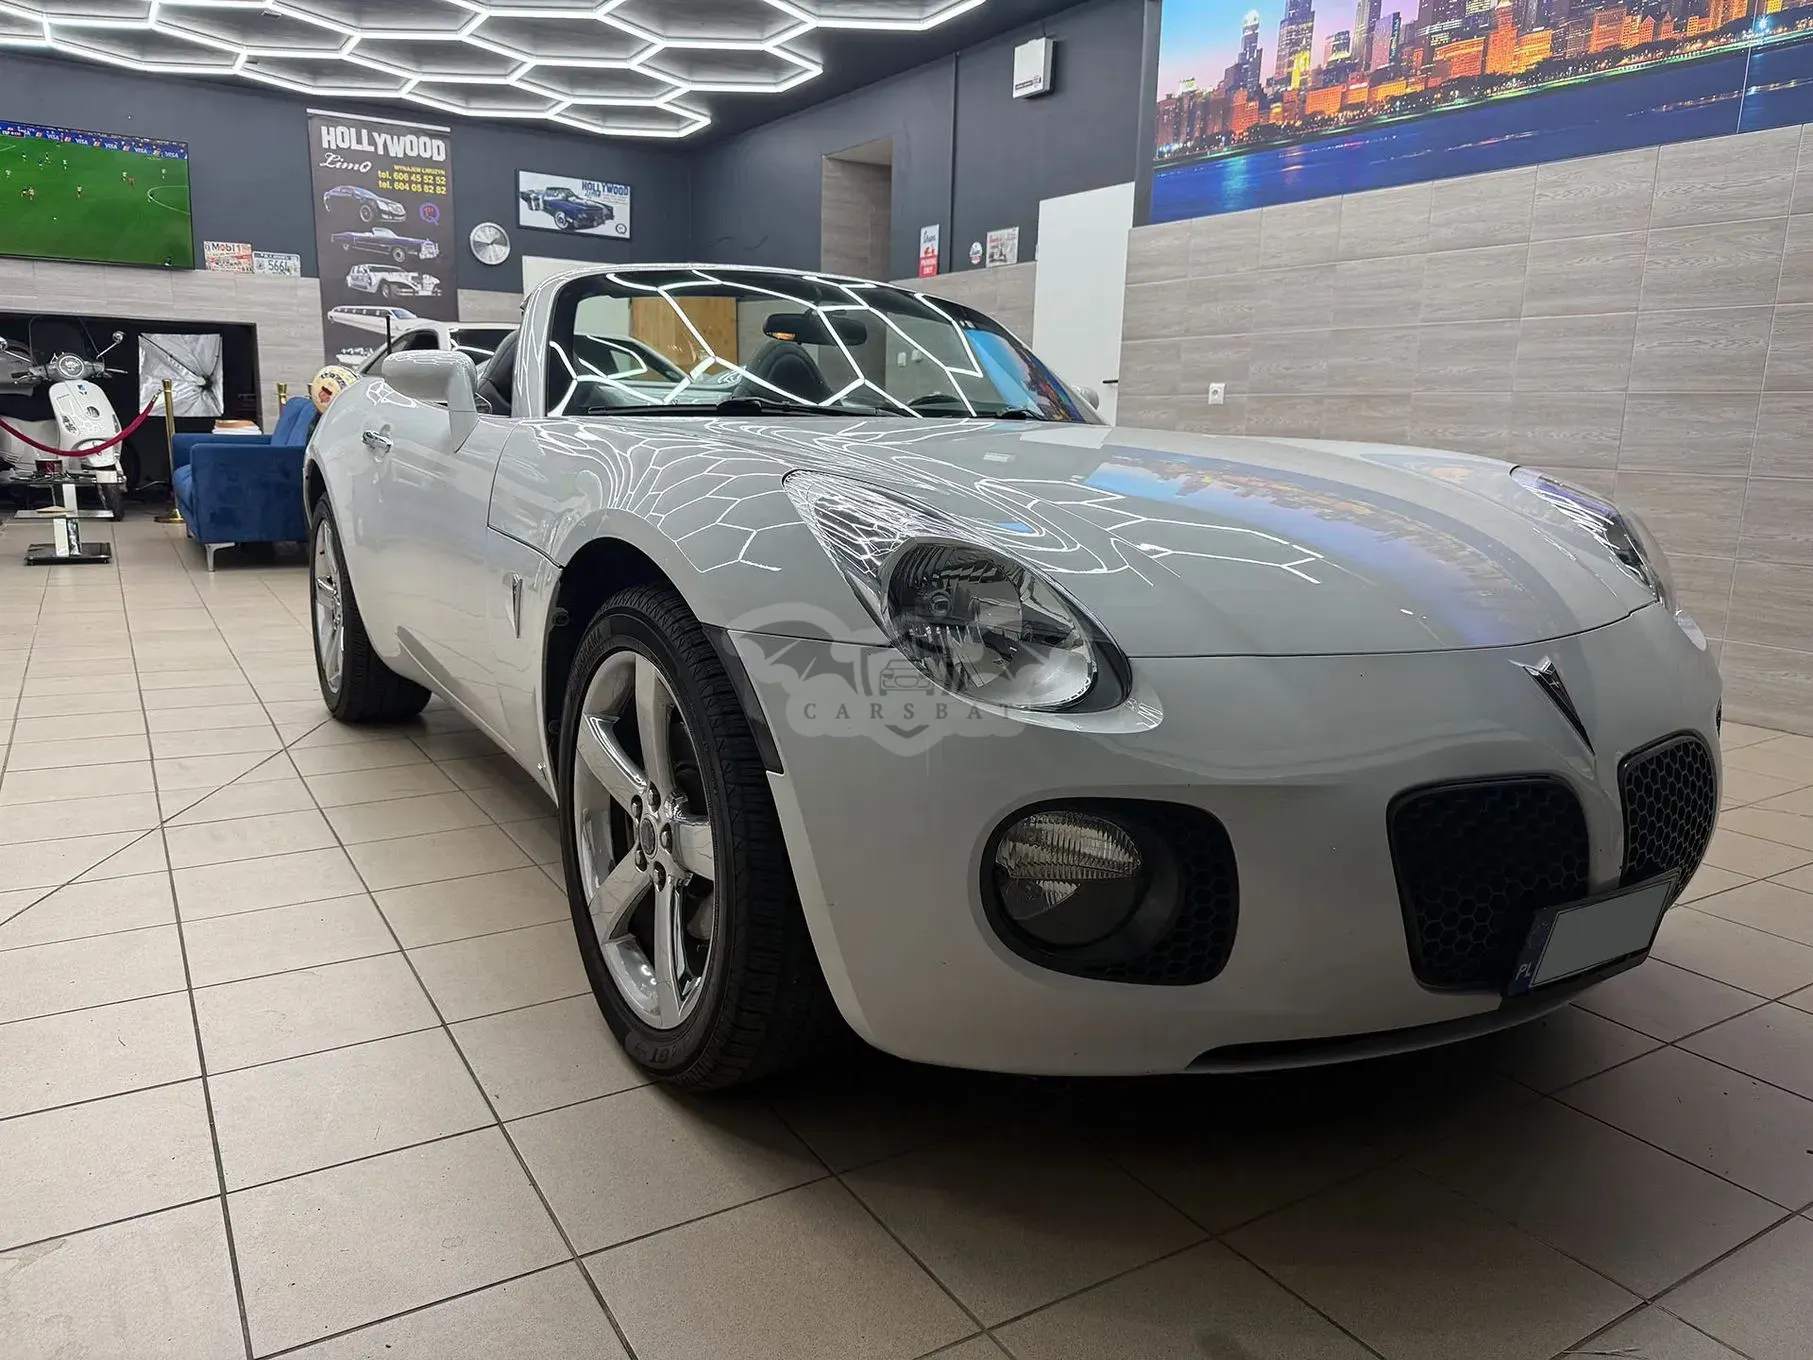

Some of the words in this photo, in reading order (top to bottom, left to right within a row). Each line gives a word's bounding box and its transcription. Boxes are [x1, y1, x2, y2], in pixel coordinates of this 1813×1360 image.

[320, 125, 447, 162] HOLLYWOOD
[378, 170, 392, 179] tel.
[411, 174, 422, 182] 45
[423, 175, 434, 184] 52
[378, 181, 393, 189] tel.
[394, 181, 410, 191] 604
[581, 180, 629, 196] HOLLYWOOD
[1514, 961, 1532, 981] PL
